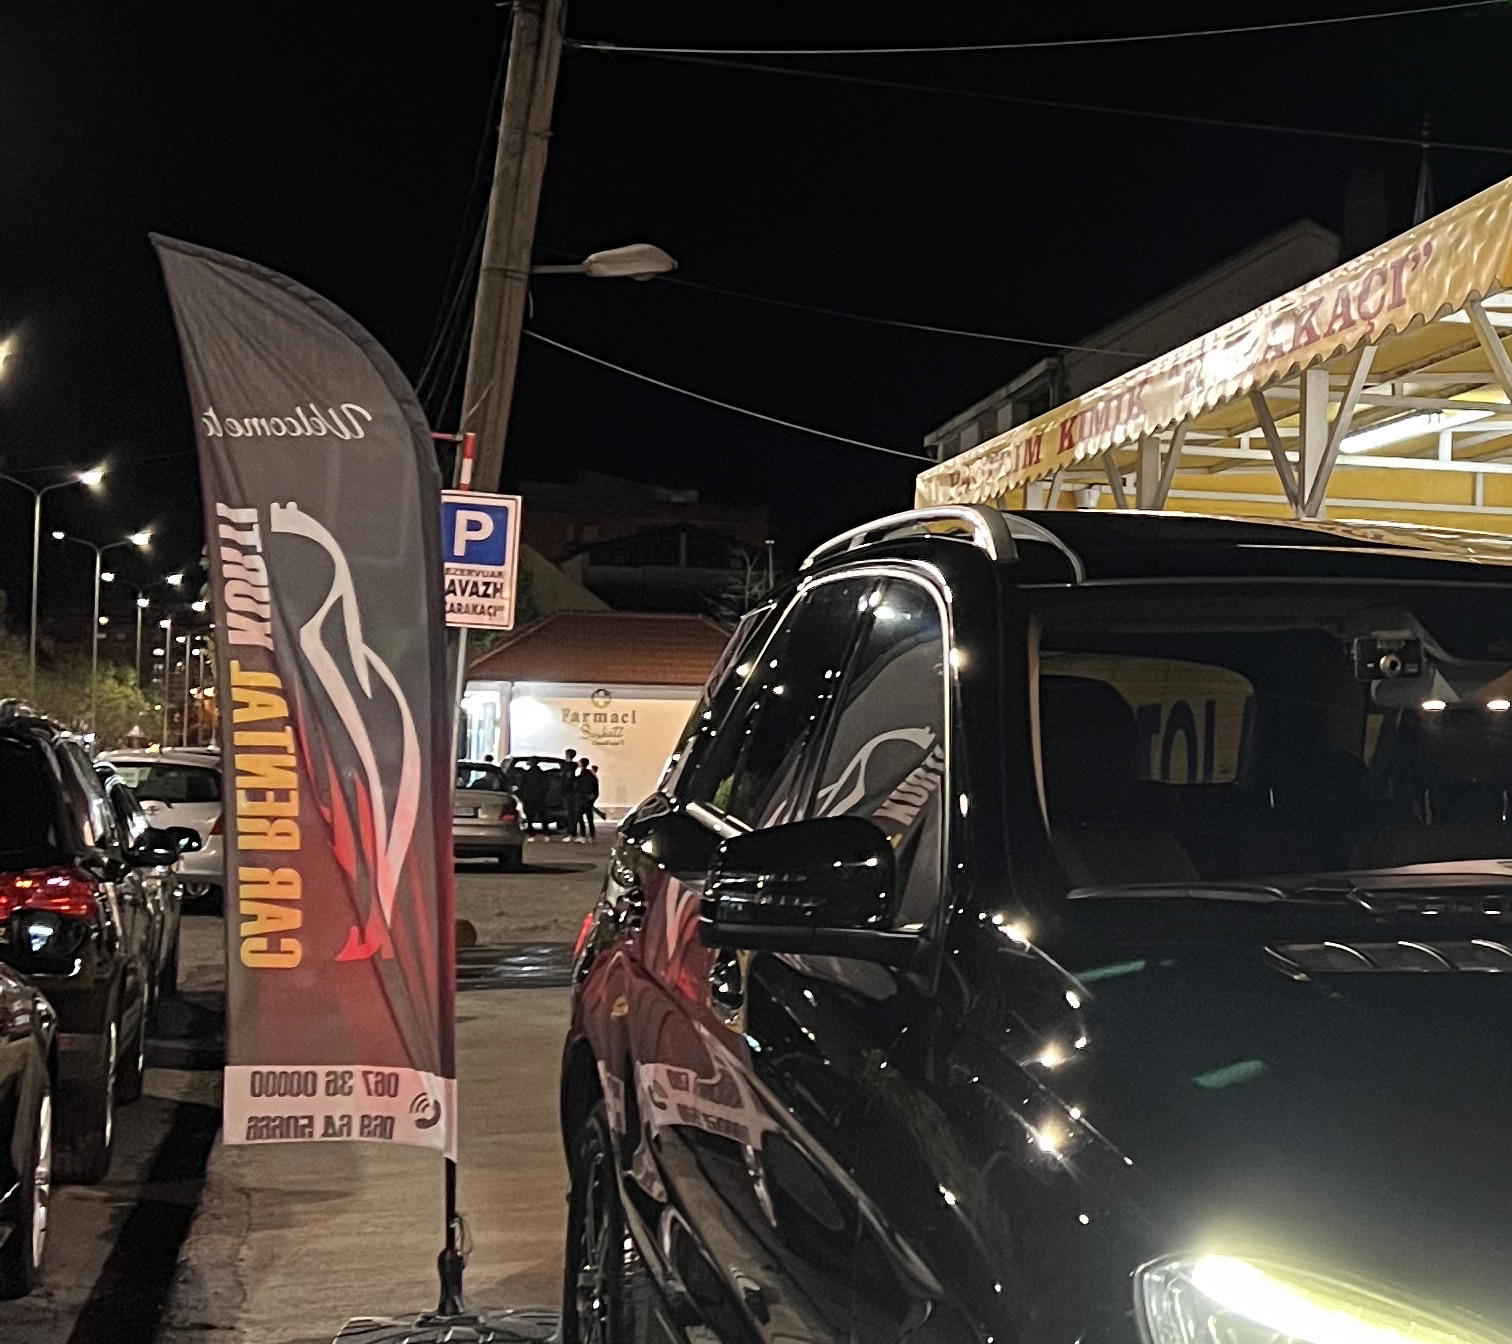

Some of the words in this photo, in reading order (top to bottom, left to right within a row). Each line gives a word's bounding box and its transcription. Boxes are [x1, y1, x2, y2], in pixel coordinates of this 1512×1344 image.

[453, 510, 495, 557] P
[445, 578, 504, 599] AVAZH
[561, 708, 637, 724] Farmaci
